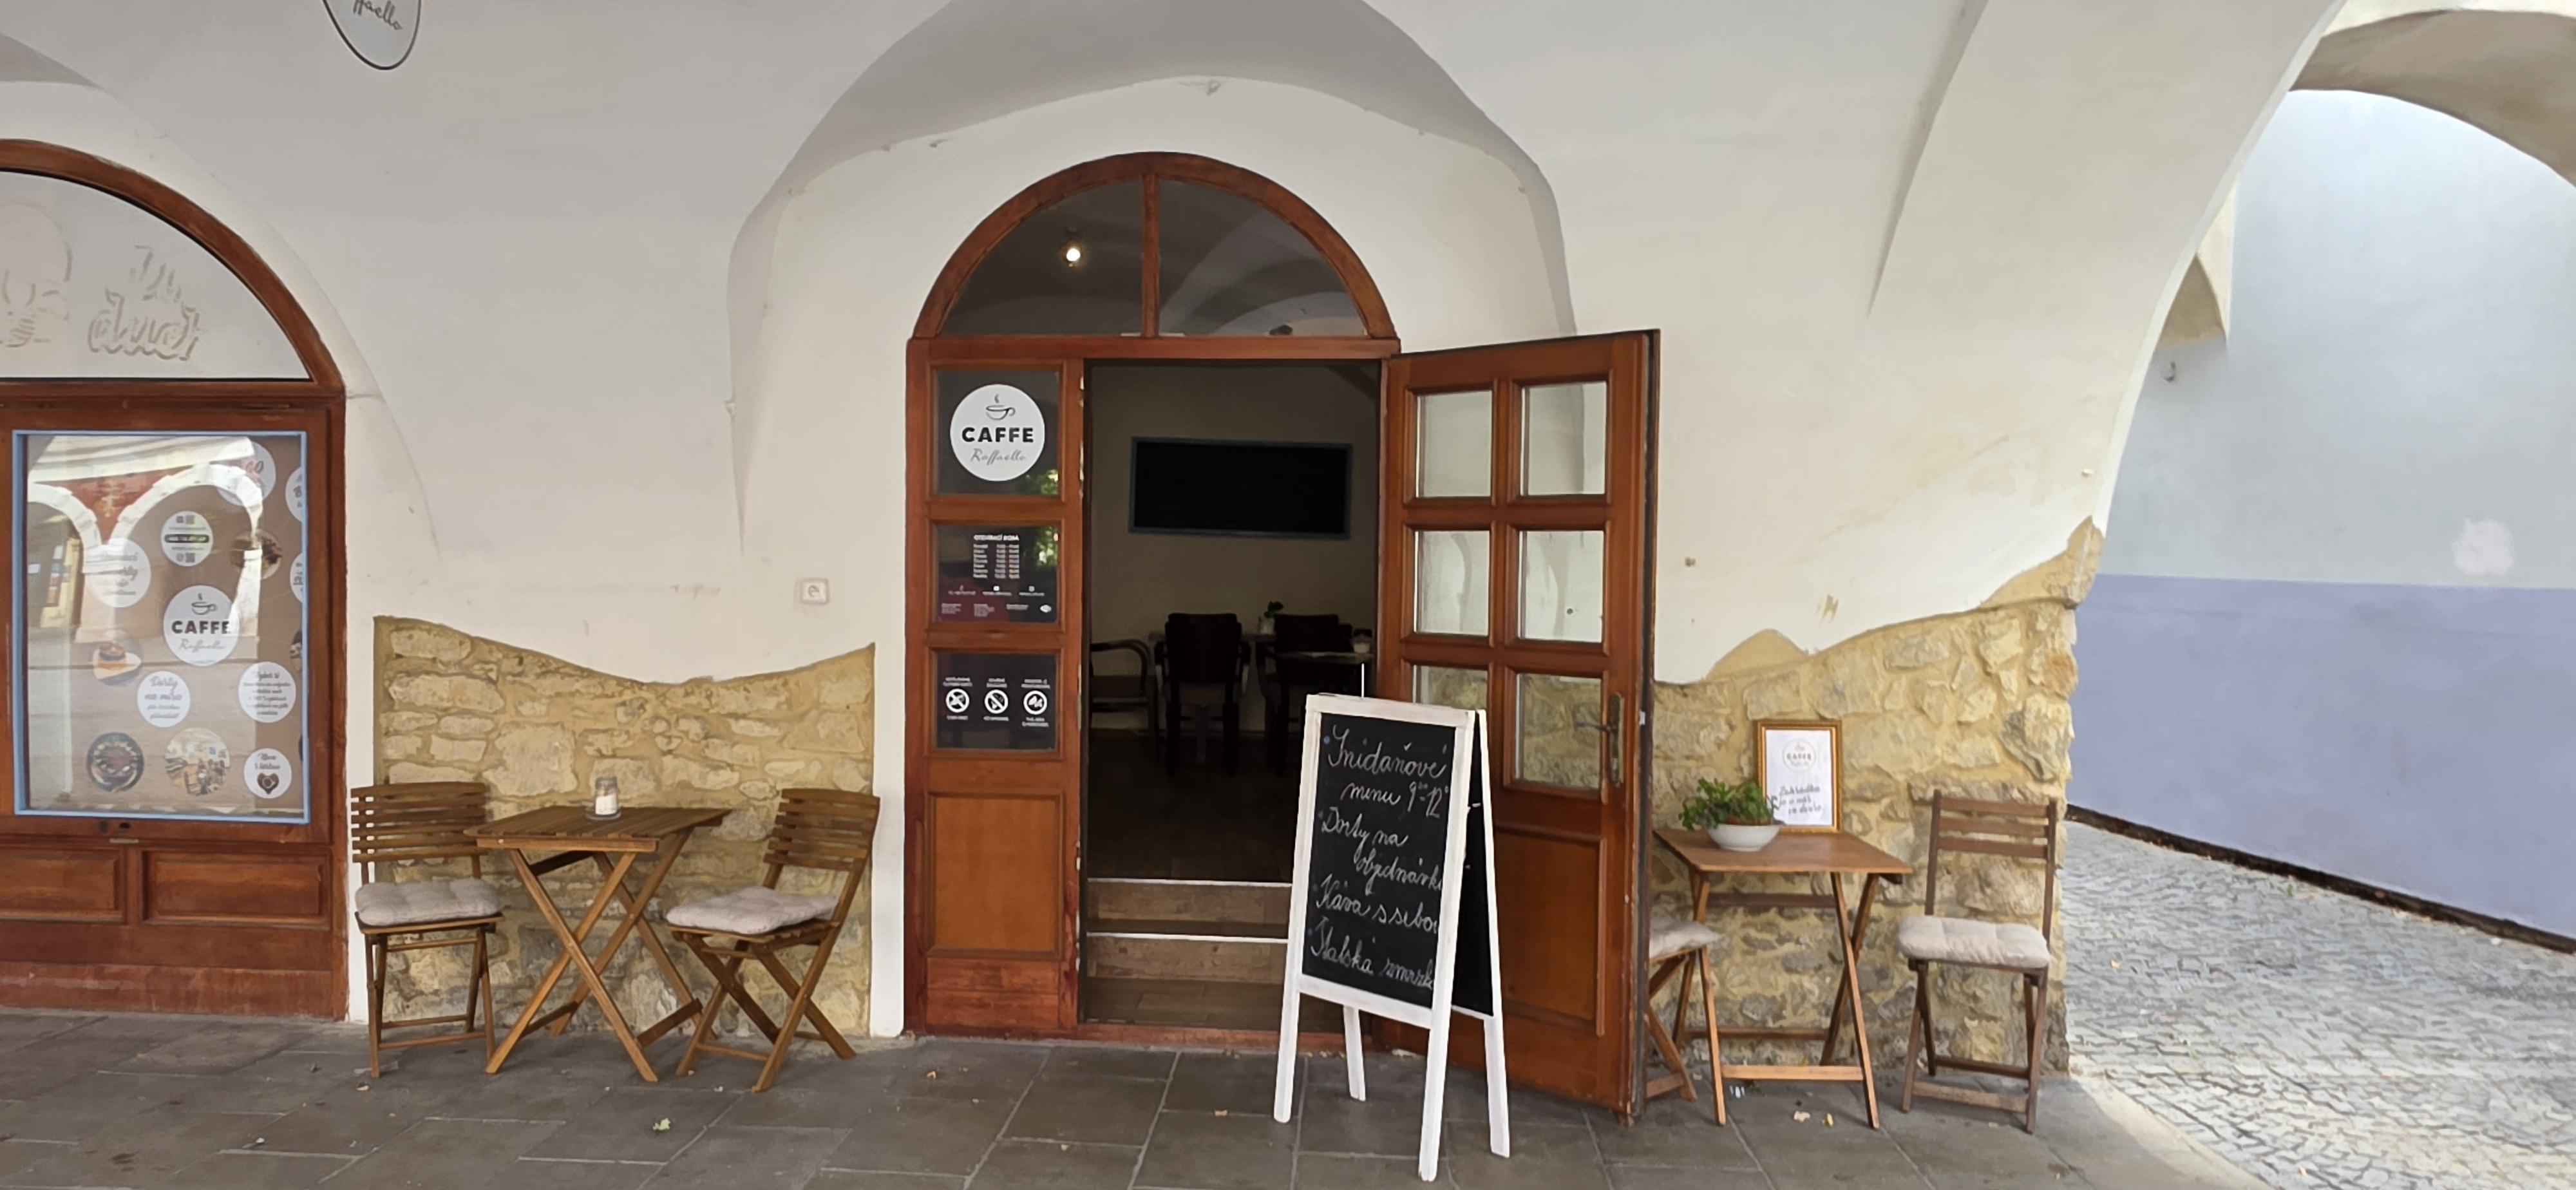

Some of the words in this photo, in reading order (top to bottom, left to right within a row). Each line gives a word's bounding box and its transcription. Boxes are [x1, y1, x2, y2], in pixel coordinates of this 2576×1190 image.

[961, 427, 1034, 443] CAFFE
[970, 448, 1027, 466] Raffaello
[171, 620, 231, 634] CAFFE
[1340, 782, 1402, 806] menu
[1321, 806, 1370, 864] Dorty
[1372, 830, 1409, 847] na
[1316, 873, 1372, 916] Káva
[1372, 903, 1388, 925] s
